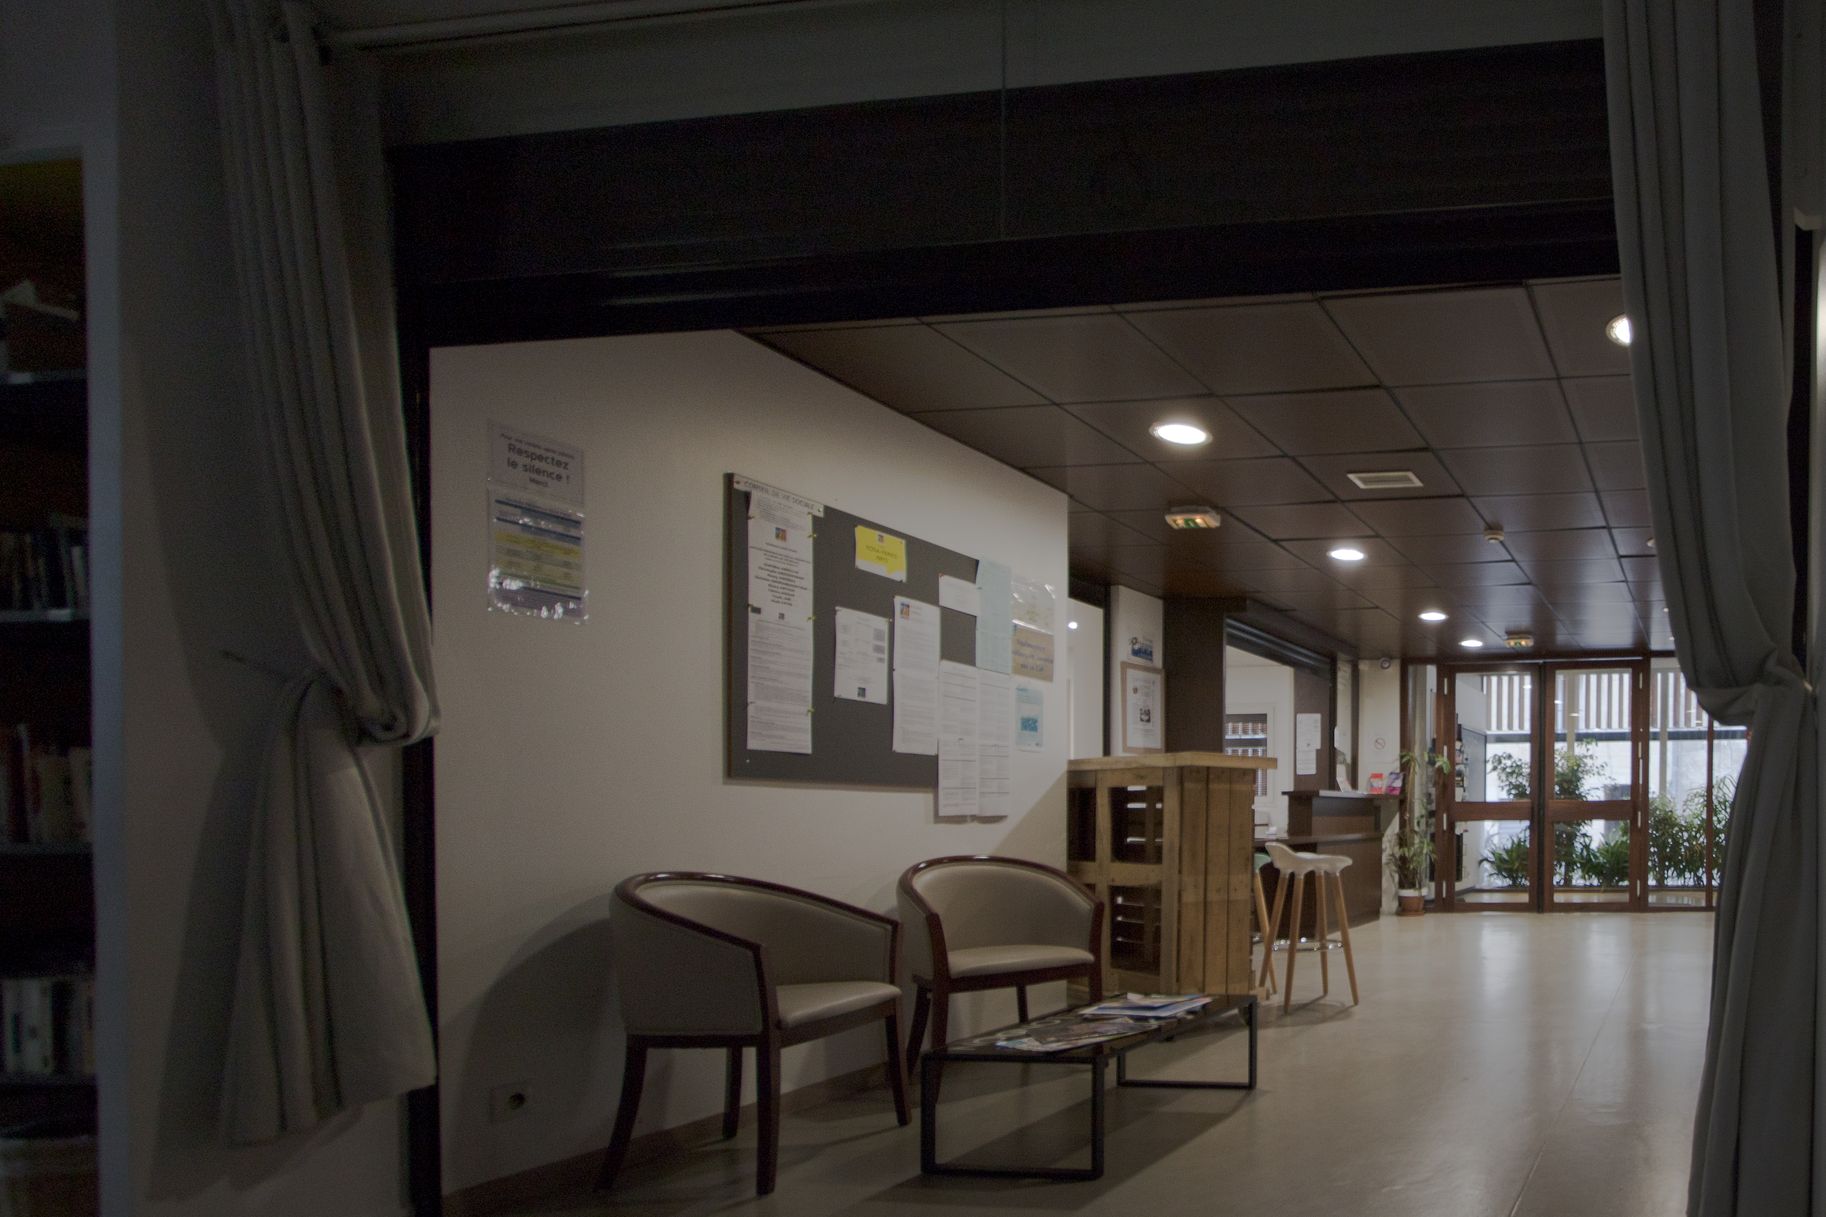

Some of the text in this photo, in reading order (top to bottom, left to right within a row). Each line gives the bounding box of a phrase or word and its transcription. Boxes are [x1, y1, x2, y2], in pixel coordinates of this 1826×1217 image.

[507, 457, 518, 470] le
[522, 464, 562, 482] silence
[508, 443, 569, 470] Respectez
